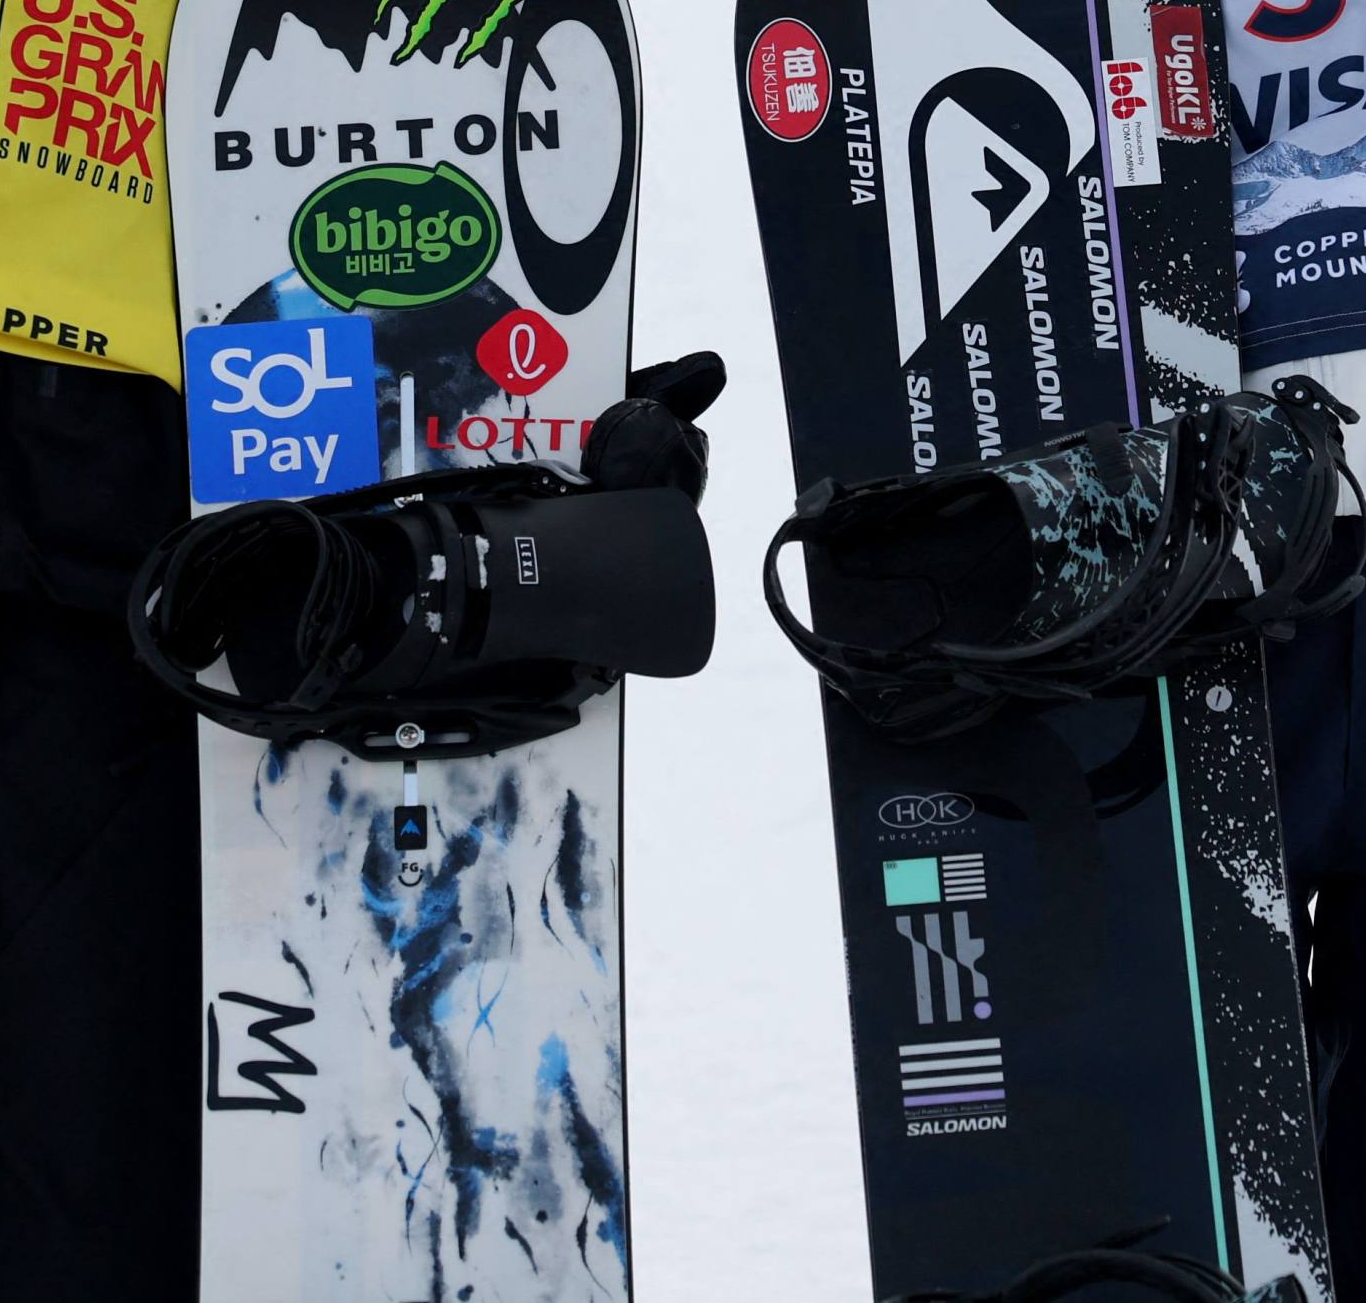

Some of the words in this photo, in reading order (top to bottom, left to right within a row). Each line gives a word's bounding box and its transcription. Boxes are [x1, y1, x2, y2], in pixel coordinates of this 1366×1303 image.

[11, 24, 165, 115] GRAN
[761, 43, 780, 121] TSUKUZEN
[4, 78, 156, 180] PRIX
[214, 109, 561, 172] BURTON
[839, 68, 876, 206] PLATEPIA
[1122, 123, 1131, 140] TOM
[1135, 121, 1145, 155] Produced
[1124, 142, 1136, 183] COMPANY
[315, 204, 483, 264] bibigo
[345, 253, 416, 277] 비비고
[1078, 175, 1119, 350] SALOMON
[1019, 245, 1064, 421] SALOMON
[962, 322, 1004, 461] SALOM
[231, 427, 340, 485] Pay
[906, 375, 937, 474] SALO
[520, 543, 534, 577] LEXA
[907, 1115, 1007, 1137] SALOMON
